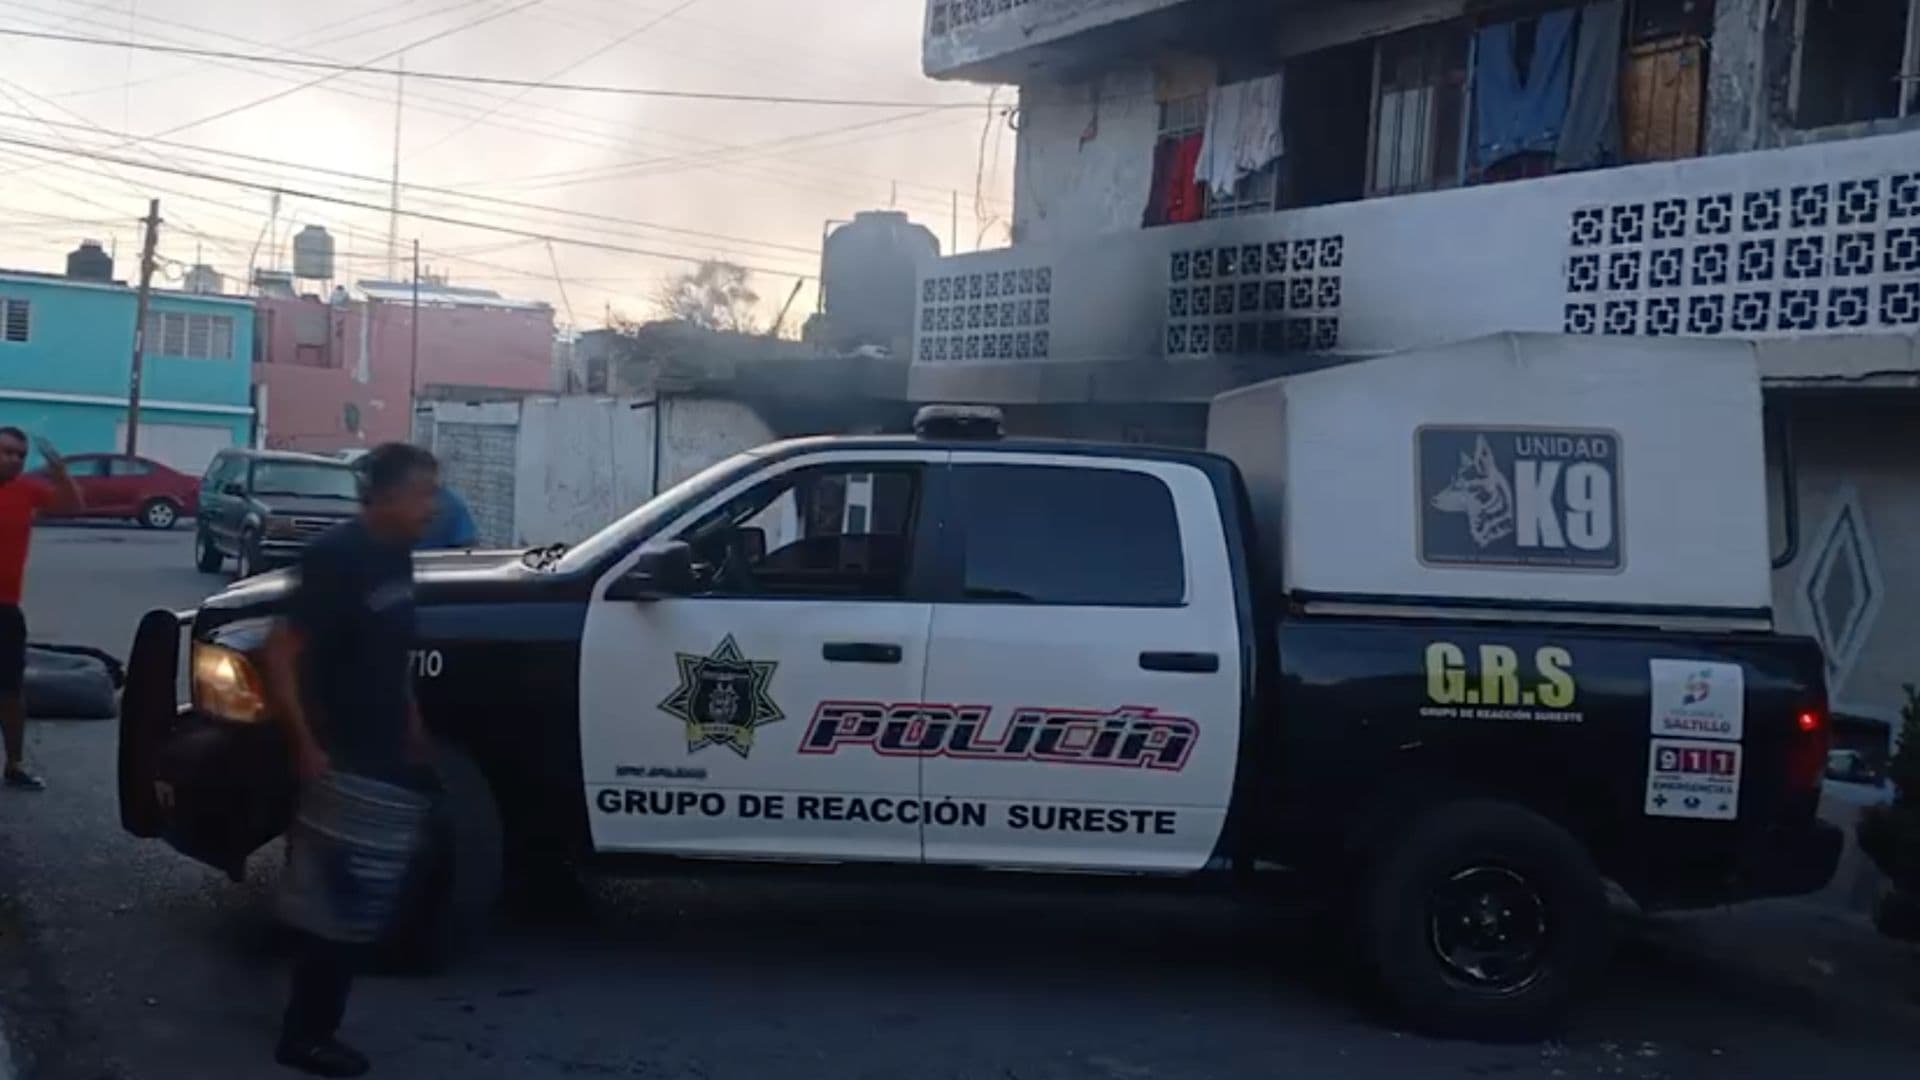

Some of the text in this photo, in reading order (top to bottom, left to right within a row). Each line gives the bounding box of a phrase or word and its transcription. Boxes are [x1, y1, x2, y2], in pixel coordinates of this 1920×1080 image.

[1515, 436, 1608, 458] UNIDAD
[1514, 460, 1613, 550] K9
[1425, 642, 1575, 708] G.R.S
[1419, 706, 1457, 718] GRUPO
[1459, 708, 1474, 719] DE
[1534, 711, 1584, 722] SURESTE
[1663, 717, 1731, 733] SALTILLO
[596, 789, 1177, 834] GRUPO DE REACCIÓN SURESTE
